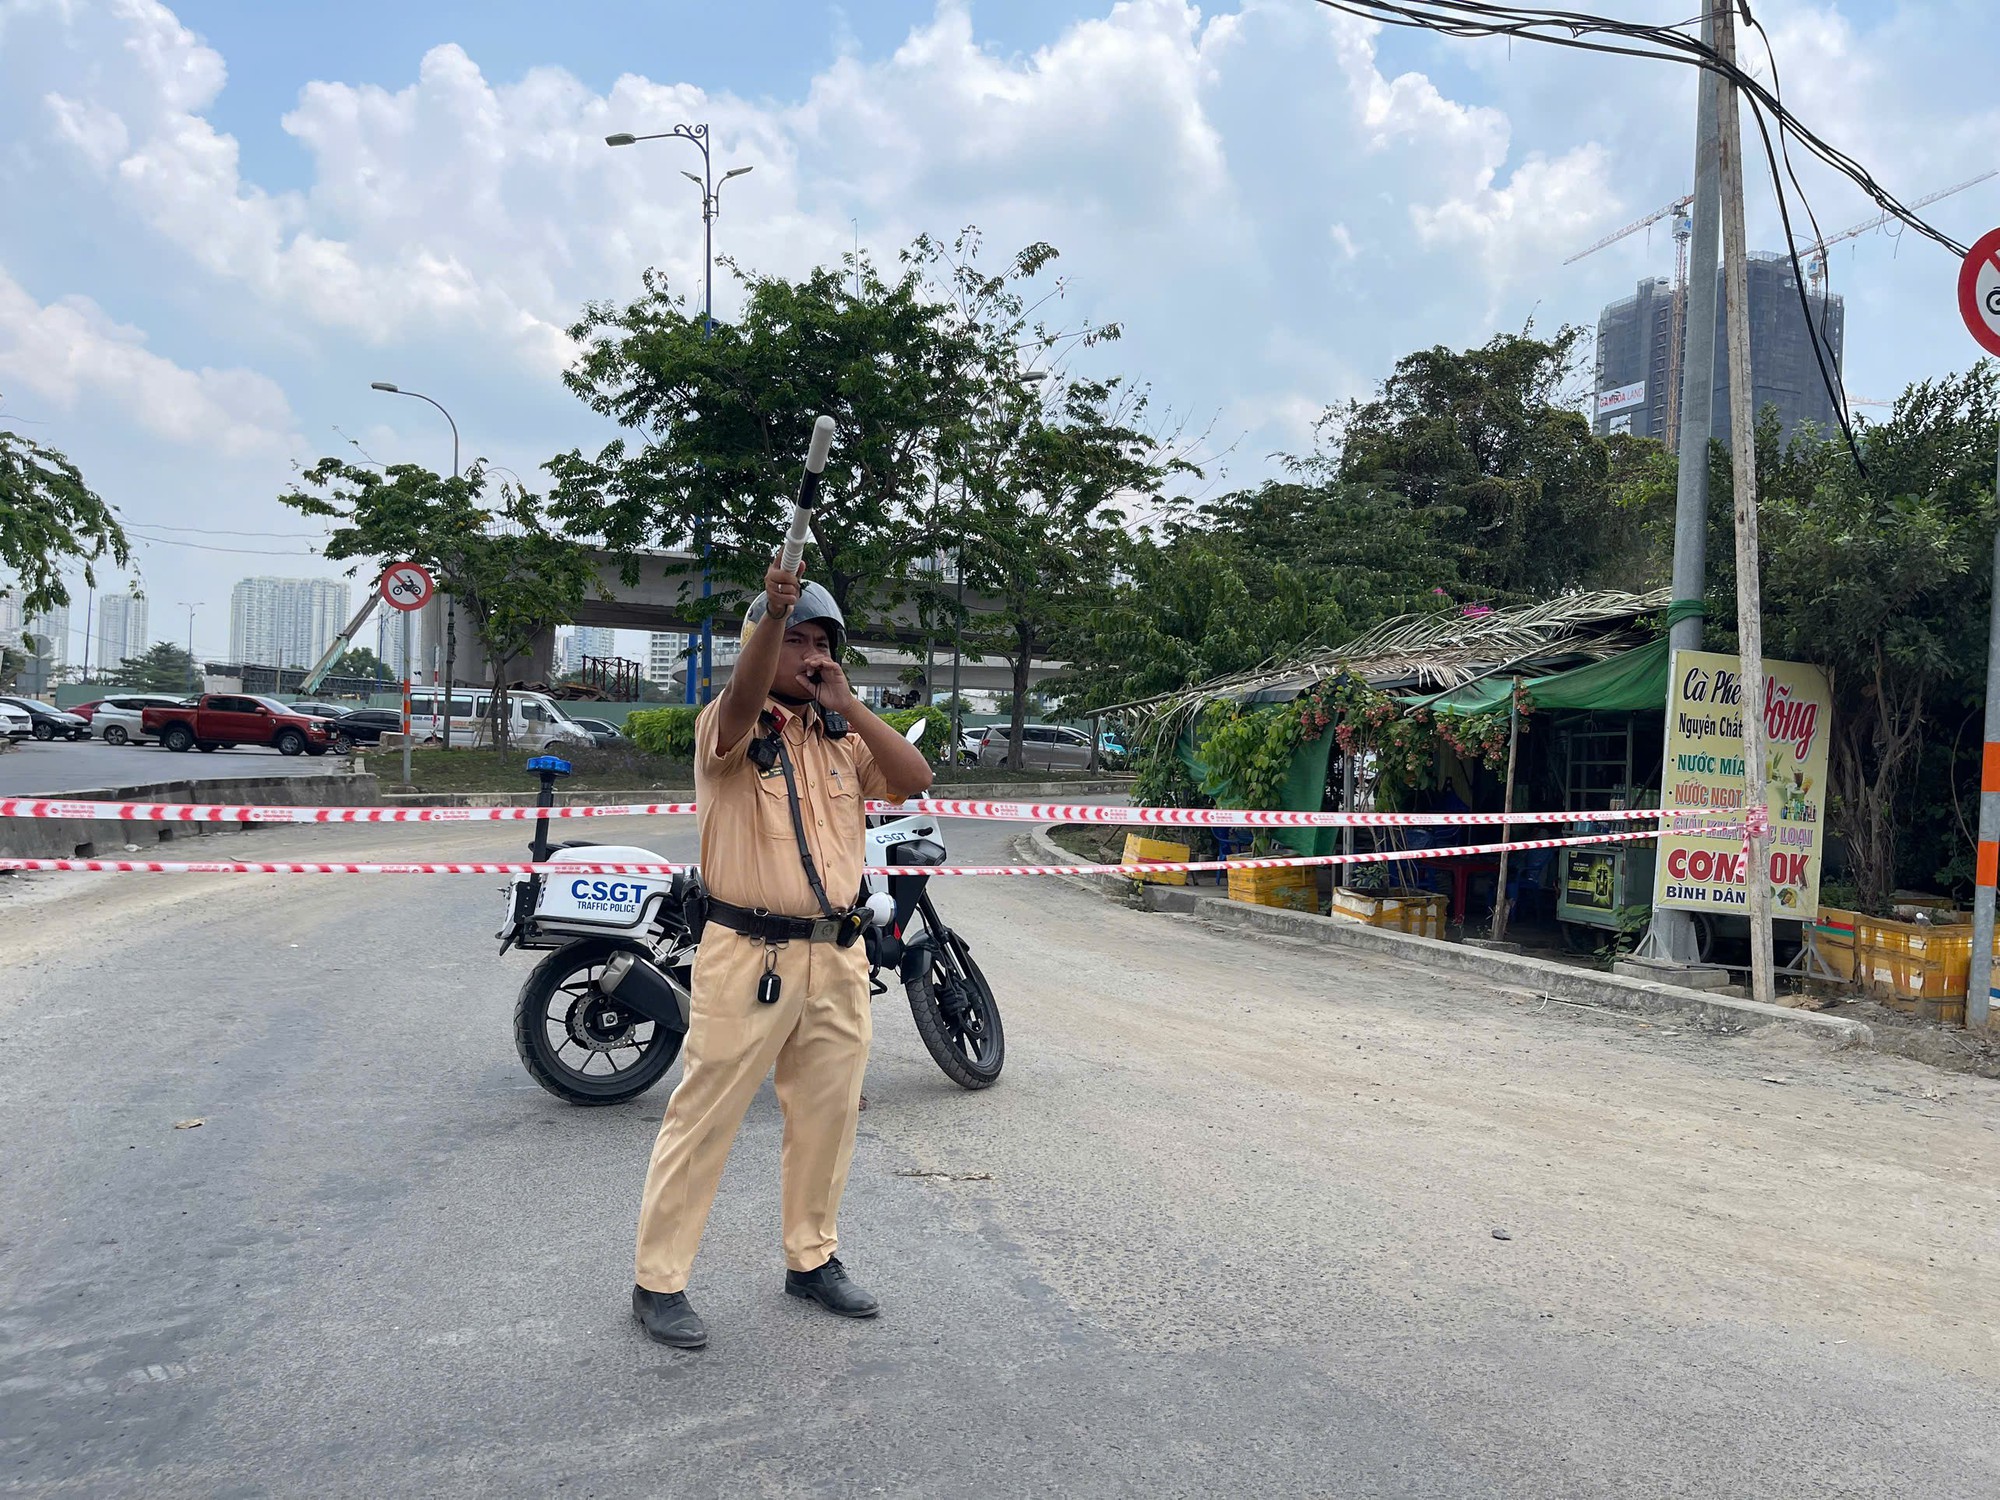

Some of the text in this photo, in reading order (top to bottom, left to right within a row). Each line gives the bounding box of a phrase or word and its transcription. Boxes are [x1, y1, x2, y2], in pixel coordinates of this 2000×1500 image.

[1683, 667, 1709, 702] Cà
[1679, 711, 1743, 739] Nguyên Chất
[1677, 751, 1745, 776] NƯỚC MÍA
[1675, 777, 1709, 806] NƯỚC
[876, 832, 907, 844] CSGT
[1667, 848, 1745, 884] CƠM
[1666, 882, 1746, 904] BÌNH DÂN
[577, 900, 636, 914] TRAFFIC POLICE
